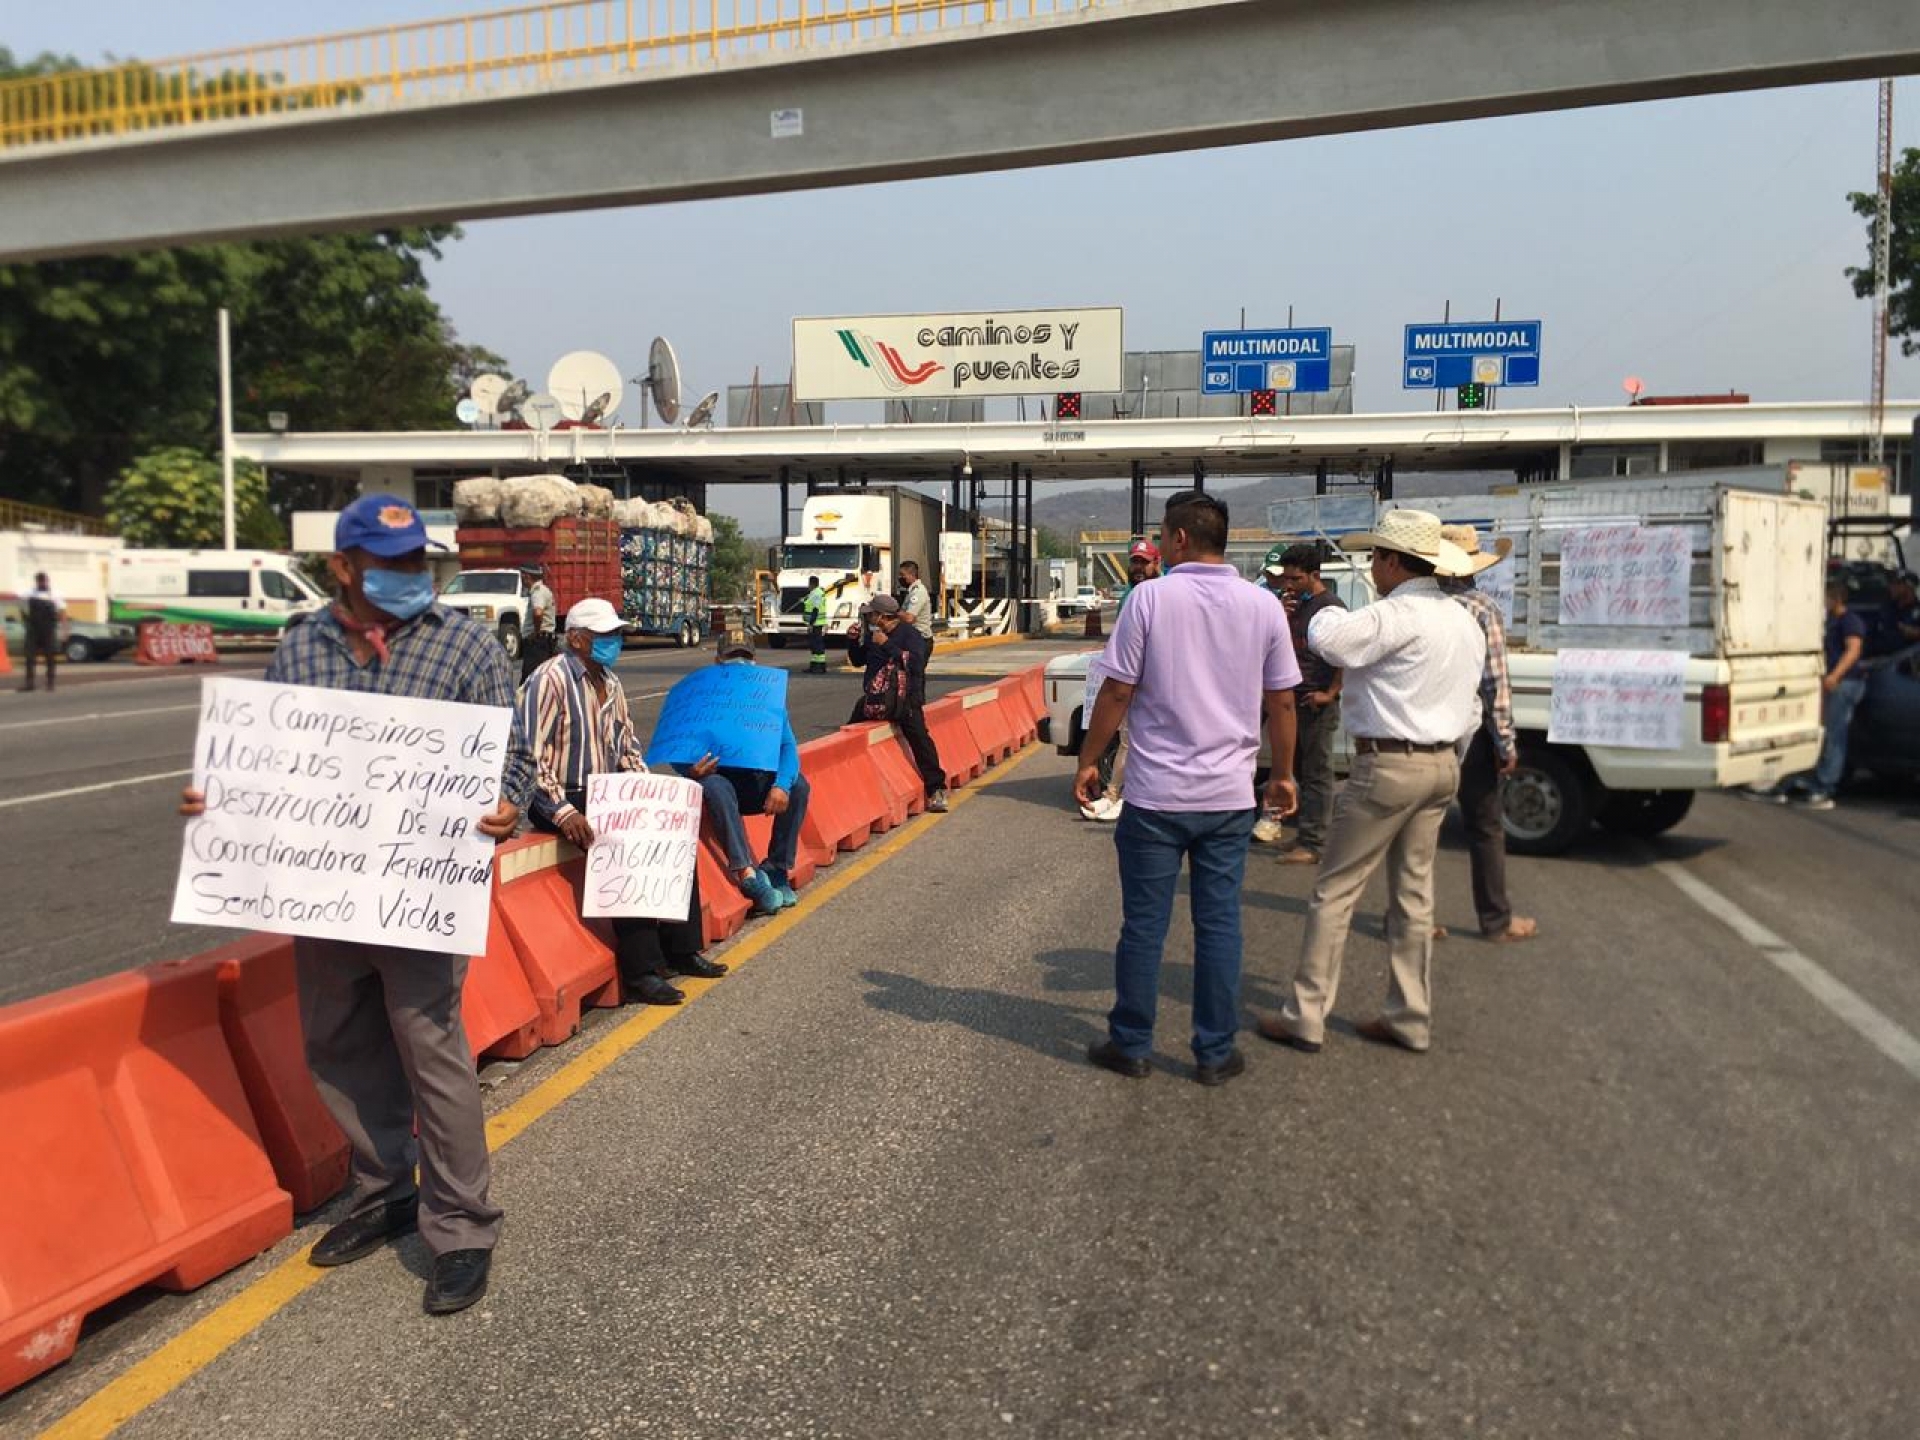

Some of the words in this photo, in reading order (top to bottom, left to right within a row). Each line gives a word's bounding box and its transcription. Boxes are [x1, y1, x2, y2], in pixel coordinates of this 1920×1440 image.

[917, 319, 1052, 348] caminos
[1058, 321, 1081, 351] Y
[1212, 338, 1321, 356] MULTIMODAL
[1415, 331, 1530, 350] MULTIMODAL
[953, 352, 1081, 389] puentes
[460, 721, 499, 764] de
[205, 734, 342, 780] MORELOS
[365, 755, 496, 809] Exigimos
[397, 808, 428, 835] DE
[440, 815, 469, 838] LA
[191, 818, 367, 876] Coordinadora
[191, 871, 356, 924] Sembrando
[378, 888, 458, 937] Vidas
